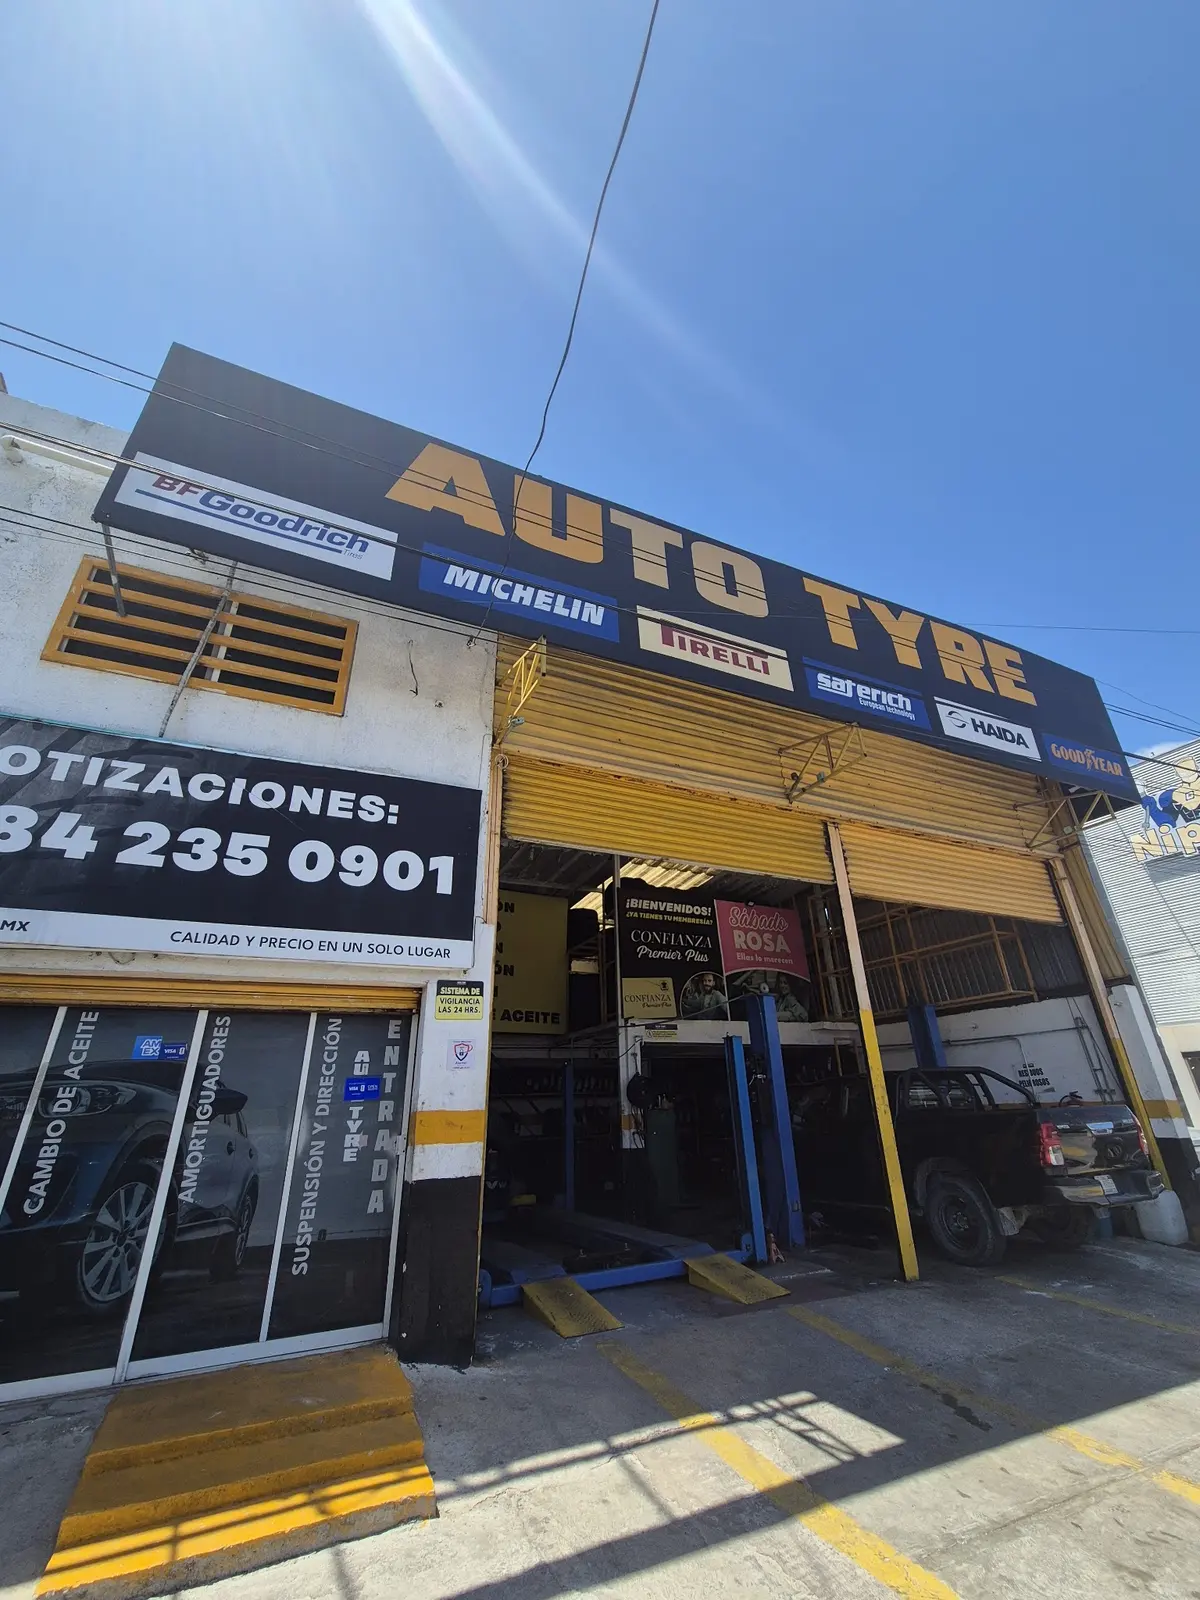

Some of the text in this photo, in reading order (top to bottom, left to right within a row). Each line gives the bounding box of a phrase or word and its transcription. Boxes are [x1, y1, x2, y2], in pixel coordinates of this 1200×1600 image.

[152, 474, 369, 553] BFGoodrich
[385, 442, 1037, 706] AUTO TYRE
[443, 564, 606, 626] MICHELIN
[661, 619, 770, 676] PIRELLI
[859, 697, 916, 721] European technology
[970, 717, 1029, 749] HAIDA
[1051, 743, 1123, 776] GOODYEAR
[115, 821, 271, 878] 235
[288, 840, 455, 895] 0901
[626, 898, 711, 916] ¡BIENVENIDOS!
[639, 912, 663, 920] TIENES
[729, 906, 788, 932] Sábado
[170, 931, 451, 959] CALIDAD Y PRECIO EN UN SOLO LUGAR
[631, 929, 712, 948] CONFIANZA
[733, 929, 791, 953] ROSA
[637, 945, 709, 962] Premier Plus
[736, 952, 754, 961] Ellas
[755, 954, 763, 962] lo
[440, 986, 480, 995] SISTEMA DE
[440, 997, 480, 1005] VIGILANCIA
[624, 994, 672, 1003] CONFIANZA
[438, 1006, 451, 1014] LAS
[464, 1006, 480, 1014] HRS.
[500, 1008, 560, 1025] ACEITE
[23, 1010, 100, 1215] CAMBIO DE ACEITE
[178, 1015, 231, 1204] AMORTIGUADORES
[291, 1017, 343, 1276] SUSPENSIÓN Y DIRECCIÓN
